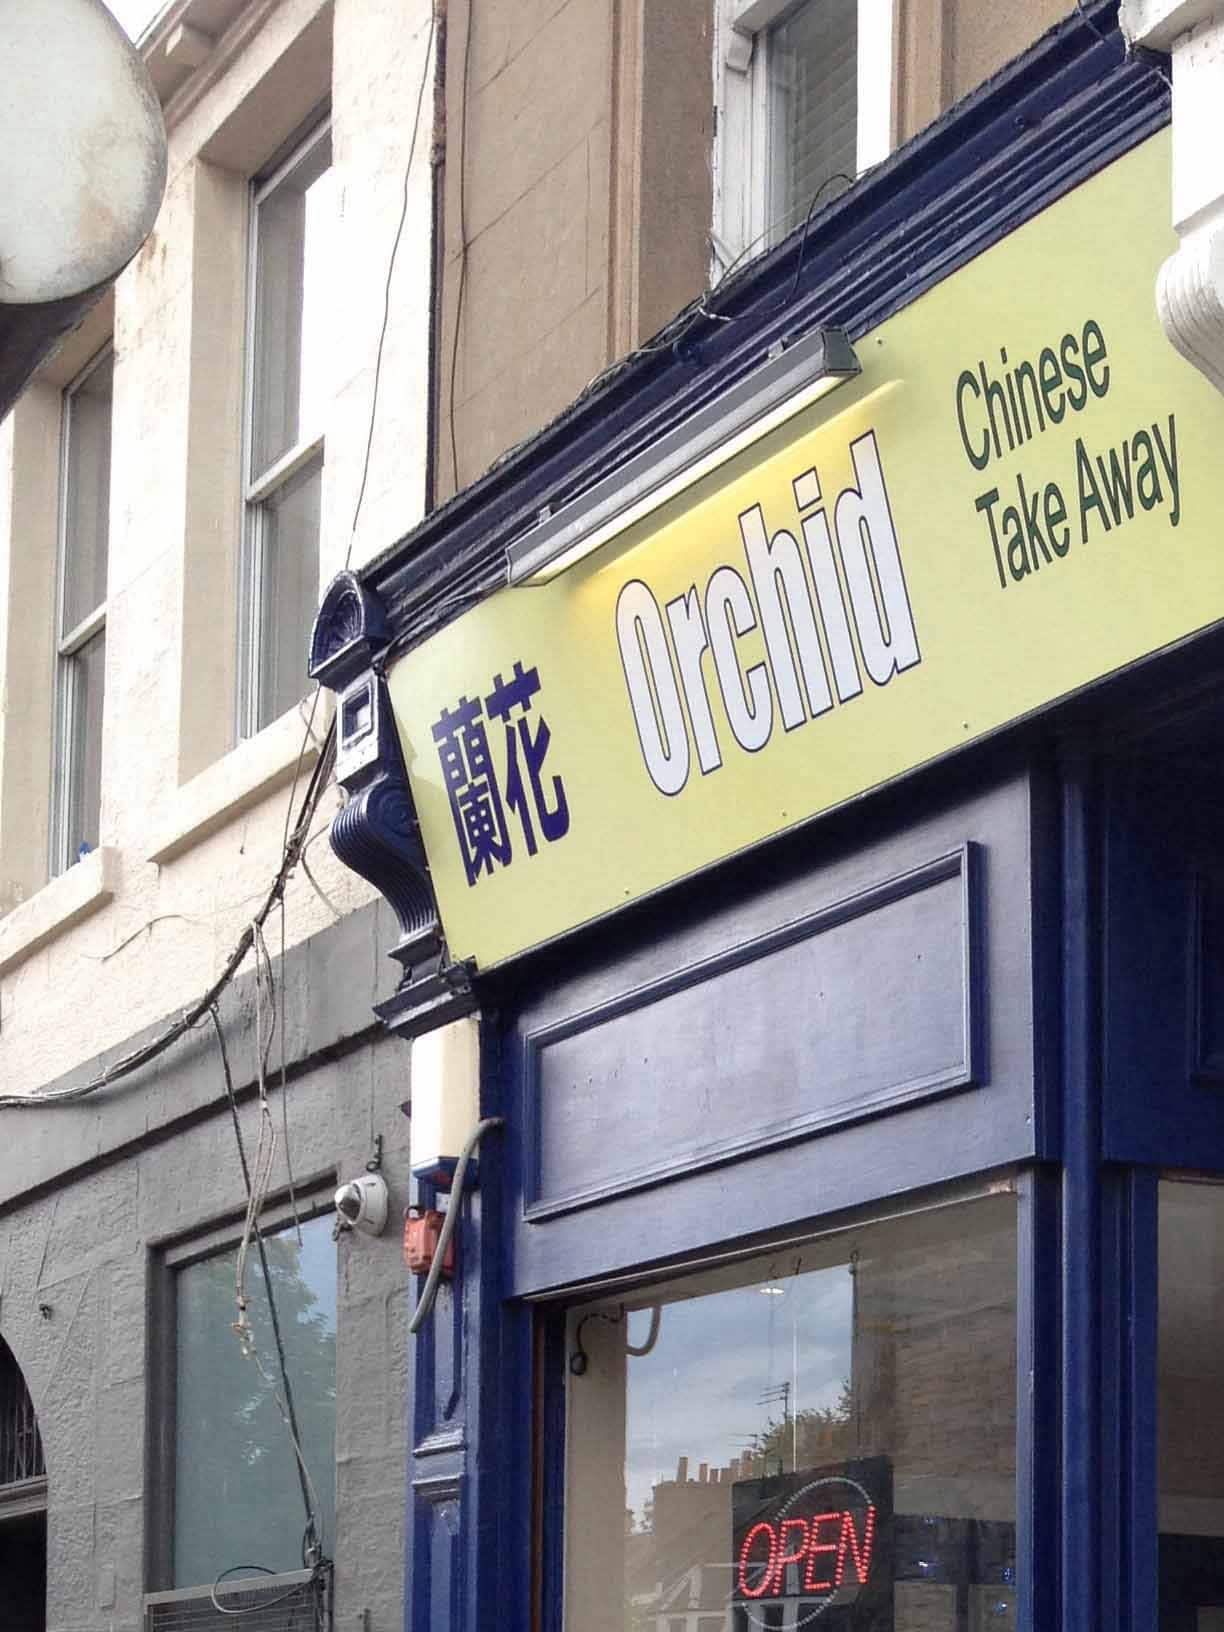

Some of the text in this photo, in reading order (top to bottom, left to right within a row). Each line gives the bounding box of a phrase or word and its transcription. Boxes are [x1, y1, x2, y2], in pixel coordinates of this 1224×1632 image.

[955, 319, 1111, 472] Chinese
[976, 414, 1181, 589] Take Away
[616, 429, 922, 797] Orchid
[431, 661, 570, 888] 蘭花
[739, 1504, 877, 1598] OPEN
